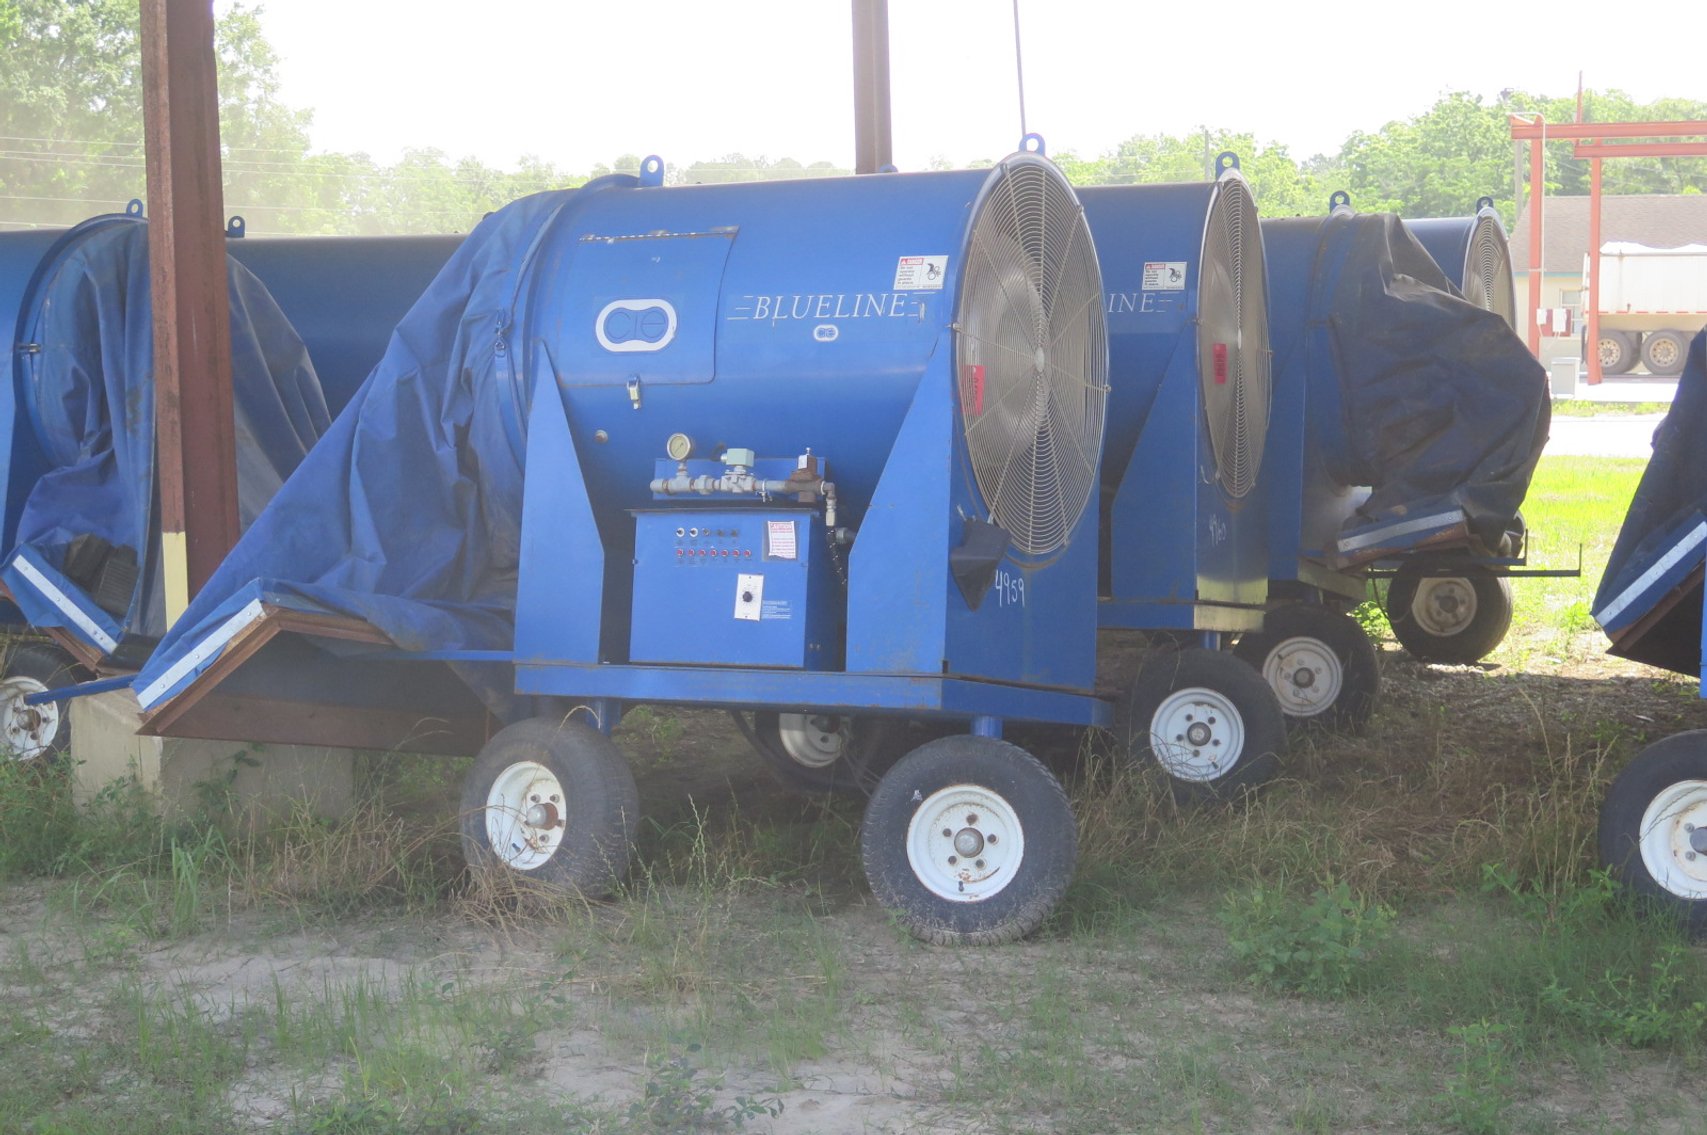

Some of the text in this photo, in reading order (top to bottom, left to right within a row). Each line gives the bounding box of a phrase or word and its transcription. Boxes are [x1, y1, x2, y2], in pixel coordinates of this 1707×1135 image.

[753, 293, 908, 321] BLUELINE
[1108, 293, 1156, 313] INE
[995, 569, 1026, 608] 4959
